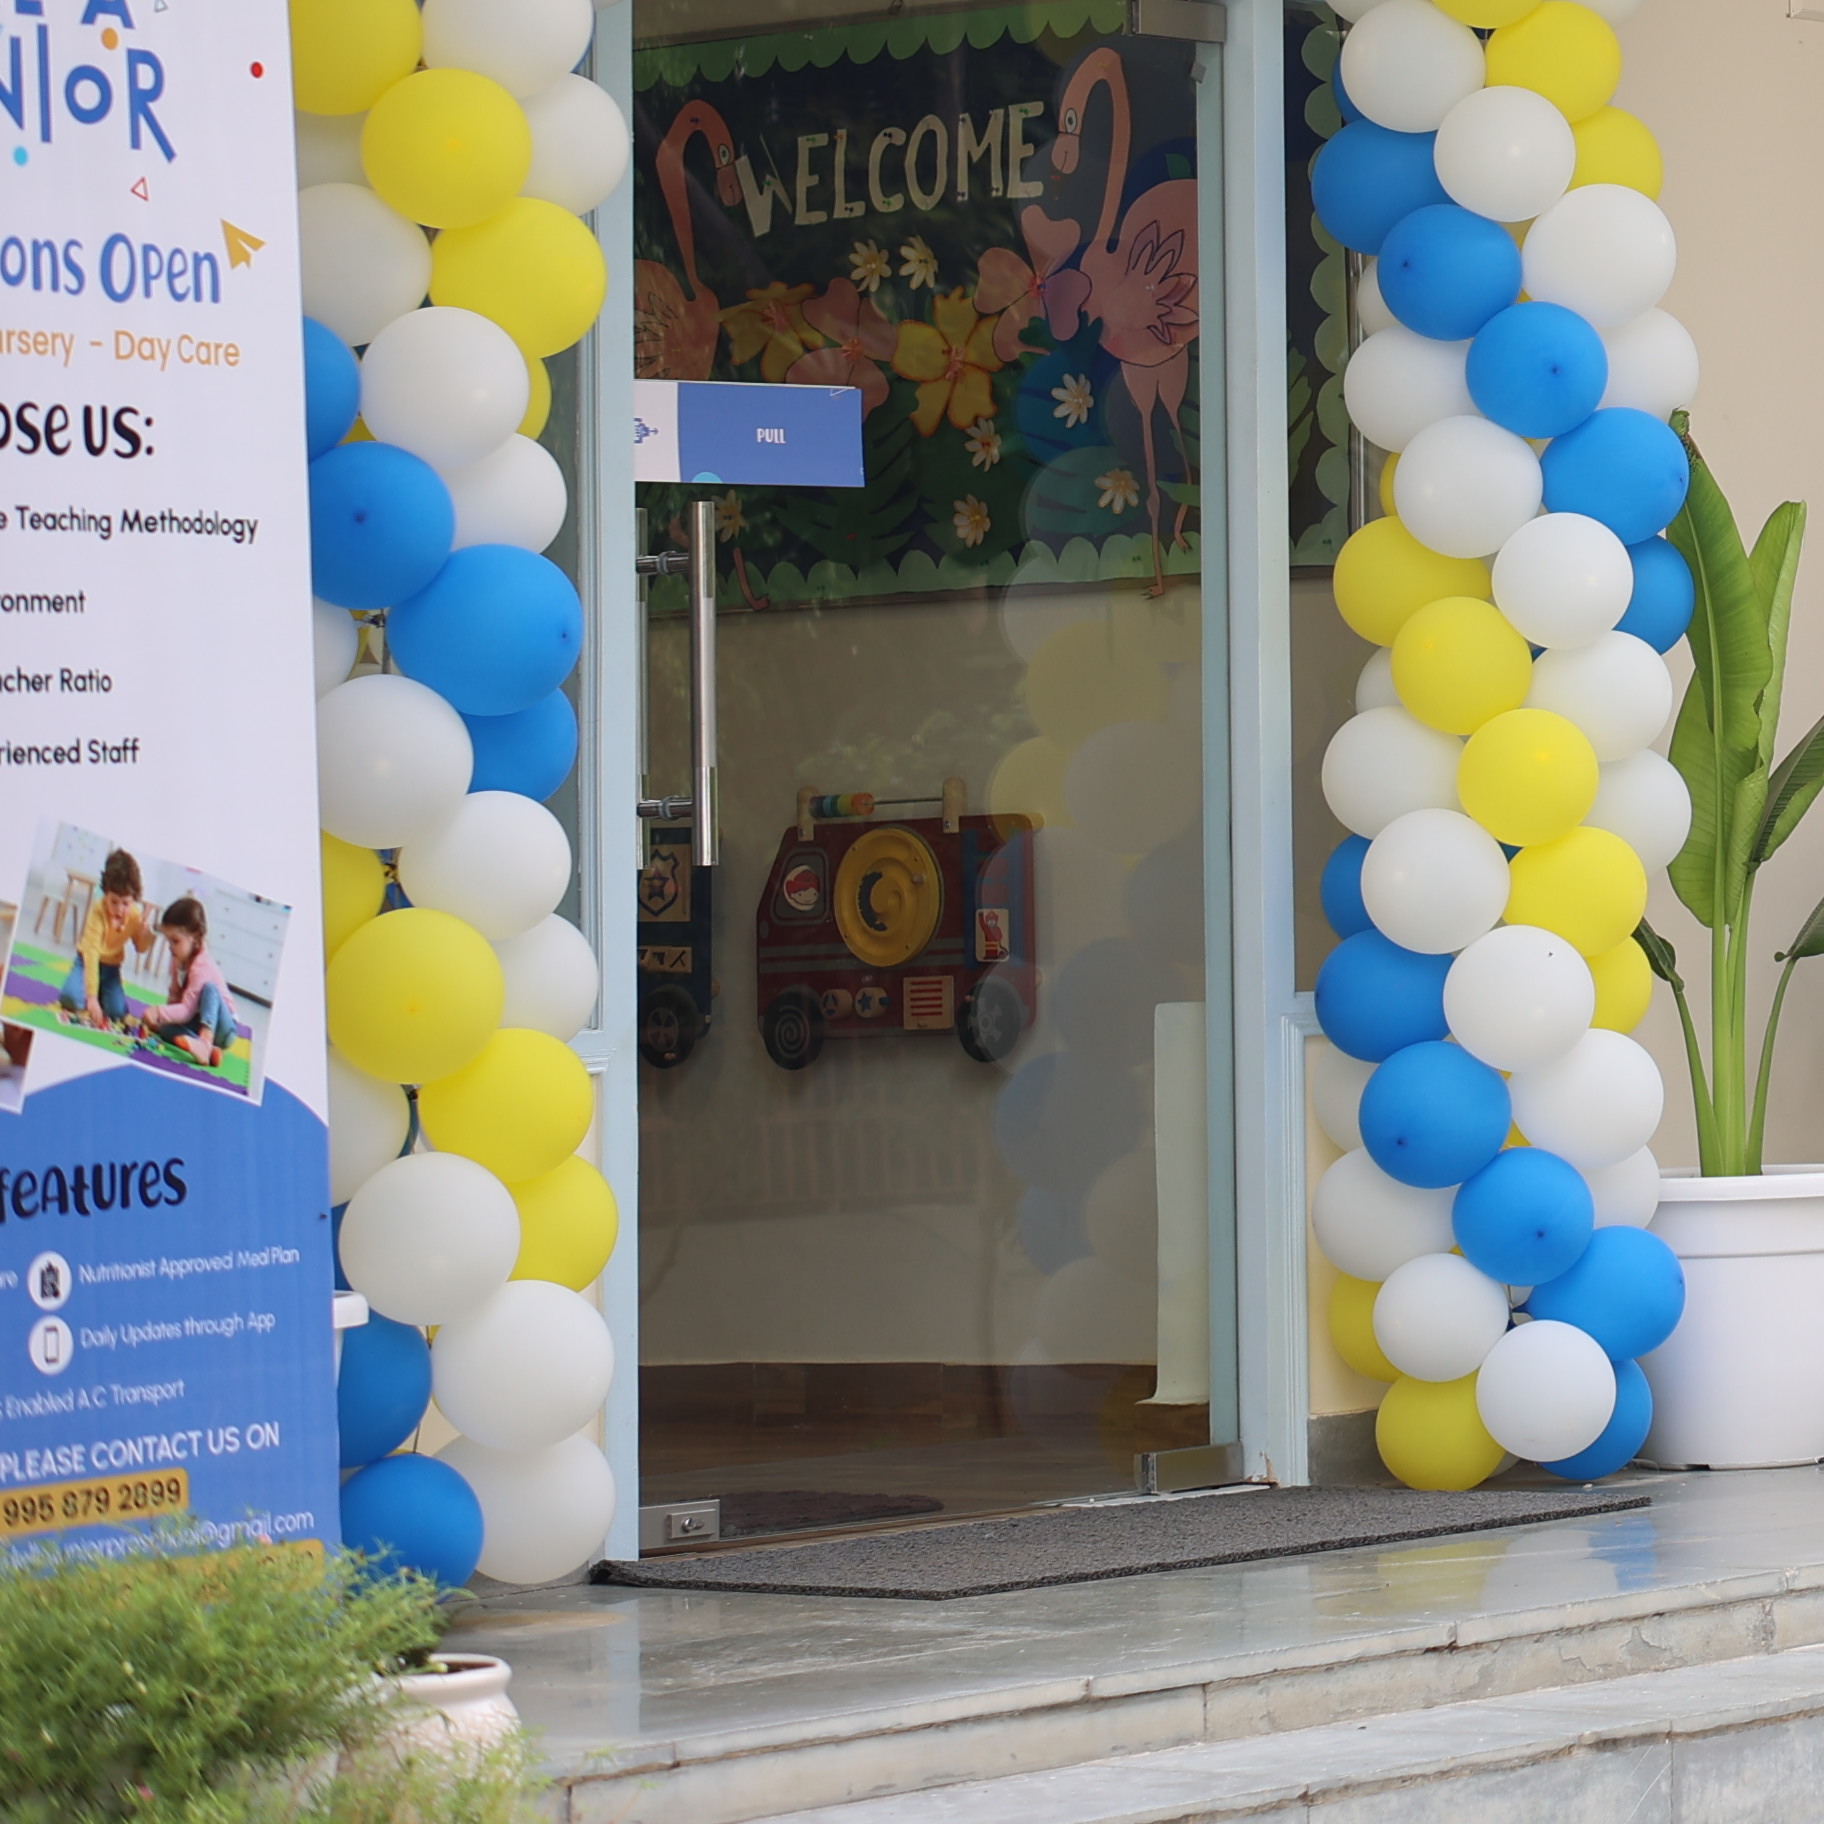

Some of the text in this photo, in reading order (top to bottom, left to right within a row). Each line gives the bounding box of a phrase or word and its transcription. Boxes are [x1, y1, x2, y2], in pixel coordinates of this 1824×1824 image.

[734, 102, 1044, 237] WELCOME
[101, 233, 220, 304] Open
[0, 329, 74, 367] rsery
[114, 330, 171, 371] Day
[177, 334, 240, 366] Care
[757, 428, 786, 444] PULL
[15, 505, 111, 540] Teaching
[120, 509, 259, 544] Methodology
[0, 589, 86, 613] onment
[0, 666, 113, 693] cher Ratio
[87, 737, 140, 764] Staff
[78, 1246, 300, 1284] Nutritionist Approved Meal Plan
[80, 1311, 276, 1350] Daily Updates through App
[5, 1388, 74, 1419] Enabled
[110, 1378, 185, 1407] Transport
[0, 1421, 280, 1483] PLEASE CONTACT US ON
[4, 1476, 181, 1526] 995 879 2899
